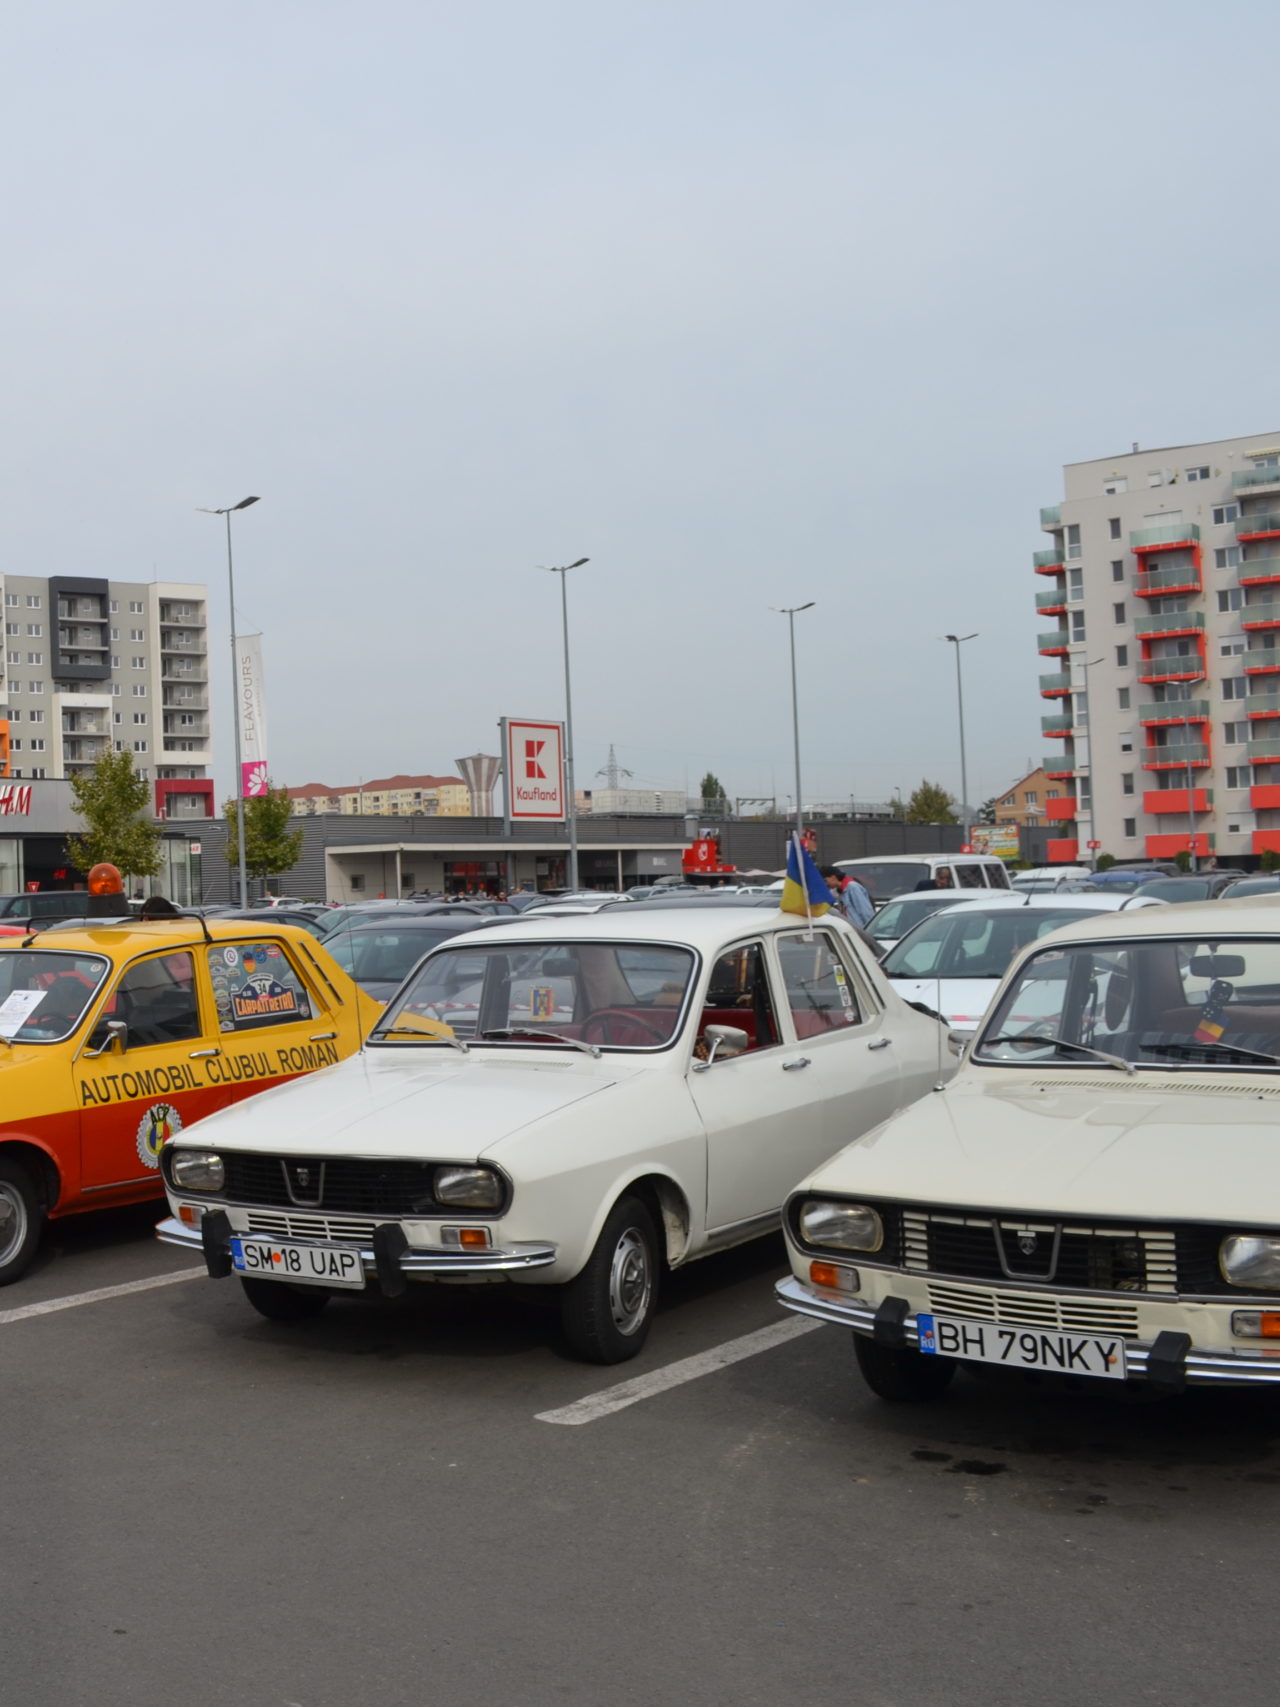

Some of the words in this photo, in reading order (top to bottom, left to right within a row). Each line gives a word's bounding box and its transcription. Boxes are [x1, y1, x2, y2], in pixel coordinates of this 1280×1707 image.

[242, 655, 254, 742] FLAVOURS
[517, 786, 557, 801] Kaufland
[80, 1063, 203, 1106] AUTOMOBIL
[205, 1052, 278, 1084] CLUBUL
[277, 1042, 339, 1073] ROMAN
[150, 1106, 170, 1125] ACR
[244, 1244, 274, 1270] SM
[281, 1248, 301, 1272] 18
[310, 1251, 355, 1277] UAP
[937, 1322, 985, 1357] BH
[998, 1330, 1117, 1372] 79NKY
